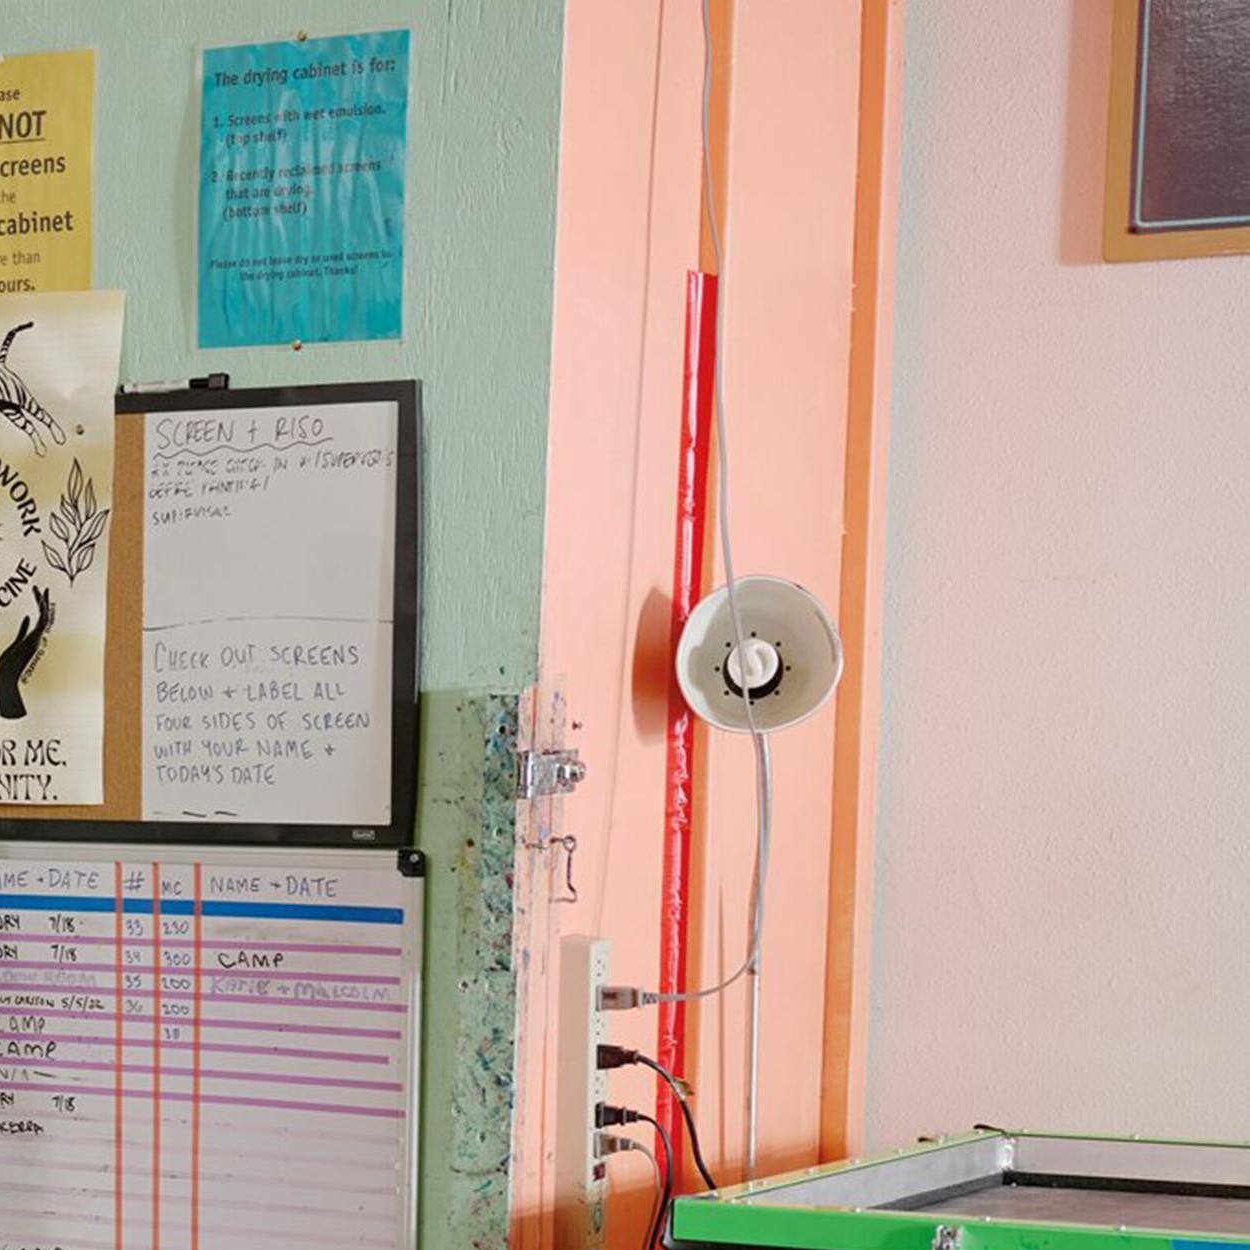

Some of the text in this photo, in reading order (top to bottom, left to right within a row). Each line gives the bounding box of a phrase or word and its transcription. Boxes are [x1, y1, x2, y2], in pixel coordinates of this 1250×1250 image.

[214, 57, 396, 87] The drying cabinet is for:
[228, 112, 270, 127] Screens
[13, 250, 41, 265] than
[156, 415, 324, 449] SCREEN + RISO
[155, 641, 359, 673] CHECK OUT SCREENS
[156, 681, 214, 703] BELOW
[246, 682, 303, 702] LABEL
[314, 682, 347, 701] ALL
[156, 711, 370, 731] FOUR SIDES OF SCREEN
[24, 739, 67, 767] ME.
[154, 741, 192, 760] WITH
[201, 739, 249, 758] YOUR
[257, 740, 313, 760] NAME
[231, 764, 276, 786] DATE
[49, 869, 100, 889] DATE
[123, 871, 145, 892] #
[162, 880, 183, 896] MC
[209, 876, 261, 893] NAME
[286, 876, 339, 897] DATE
[217, 951, 285, 969] CAMP
